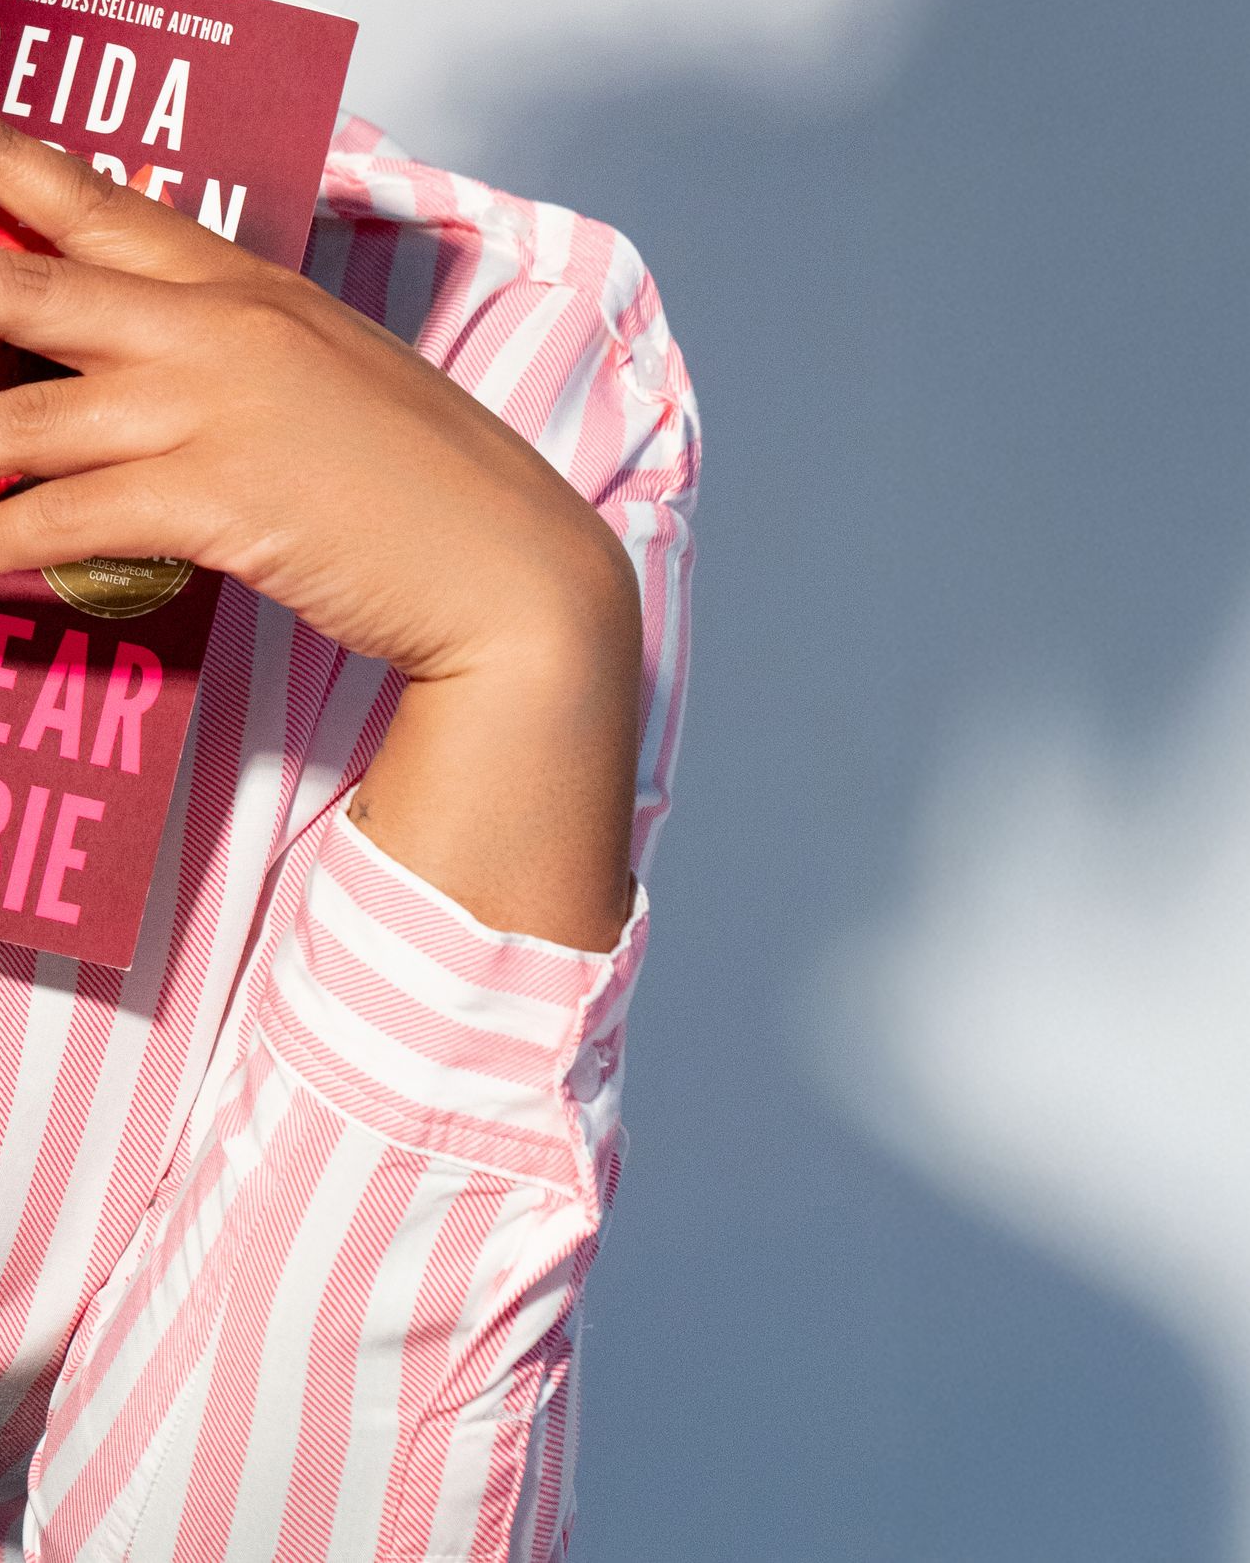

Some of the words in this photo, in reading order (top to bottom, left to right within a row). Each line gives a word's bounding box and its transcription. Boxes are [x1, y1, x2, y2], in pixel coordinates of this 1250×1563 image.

[167, 10, 233, 45] AUTHOR
[78, 557, 116, 571] CLUDES
[118, 564, 154, 579] SPECIAL
[89, 570, 131, 586] CONTENT
